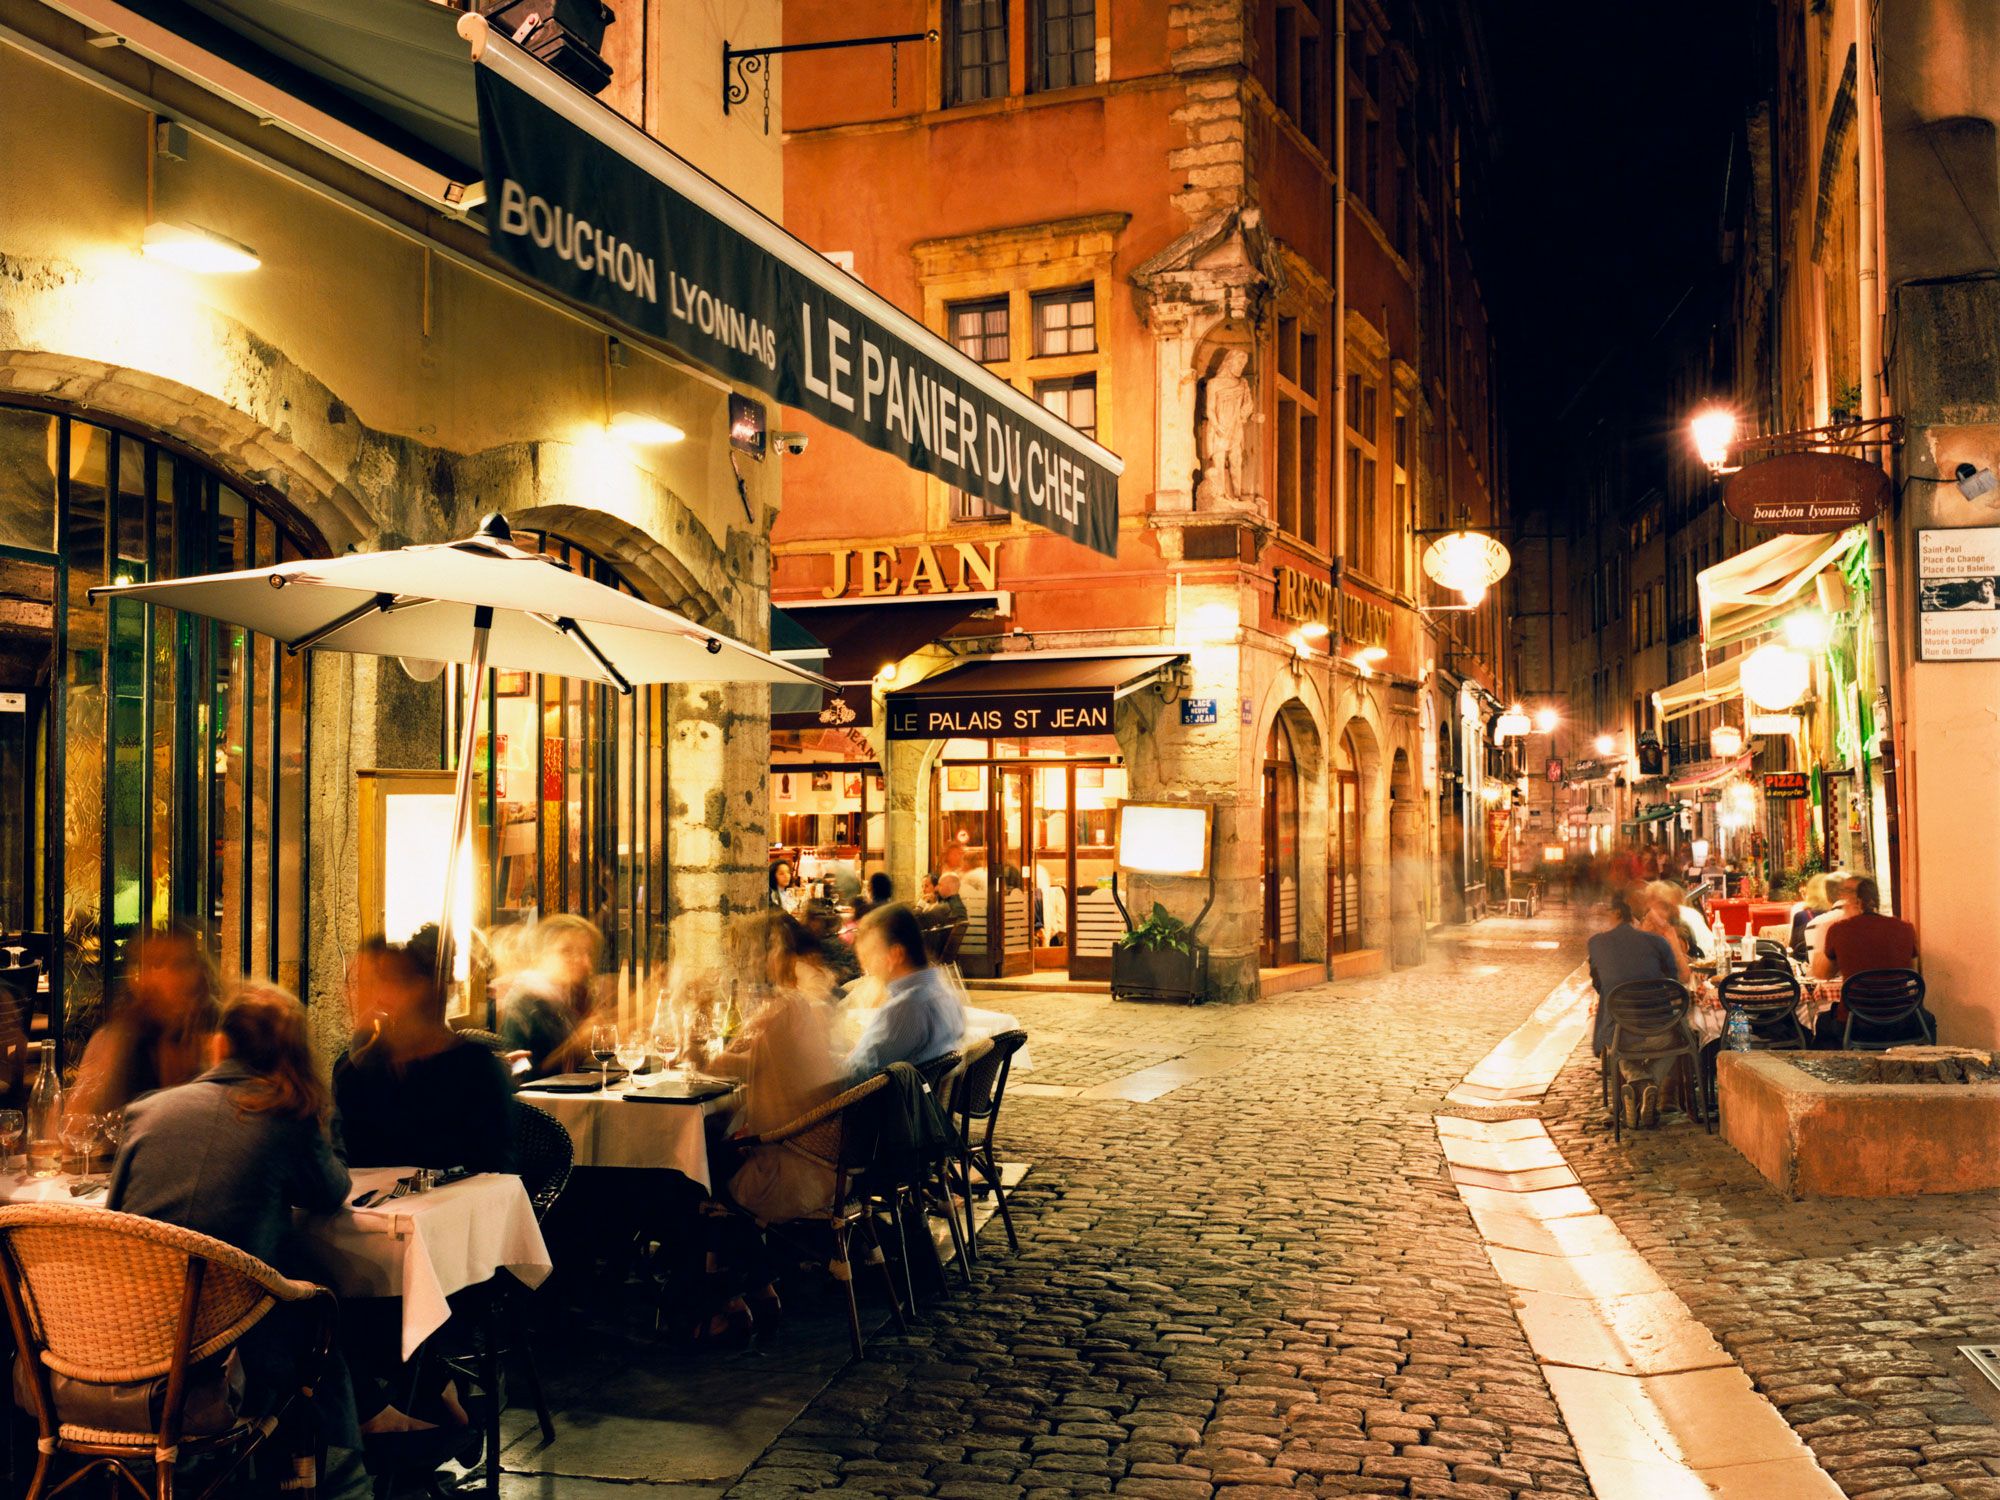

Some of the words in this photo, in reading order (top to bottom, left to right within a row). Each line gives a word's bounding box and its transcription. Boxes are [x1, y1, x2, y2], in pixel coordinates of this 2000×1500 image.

[500, 178, 657, 304] BOUCHON
[669, 270, 776, 371] LYONNAIS
[802, 303, 855, 413] LE
[862, 339, 982, 477] PANIER
[986, 412, 1022, 495] DU
[1026, 440, 1086, 525] CHEF
[1753, 505, 1804, 519] bouchon
[1808, 503, 1861, 519] lyonnais
[1922, 545, 1962, 554] Saint-Paul
[1956, 555, 1985, 564] Change
[821, 541, 1001, 599] JEAN
[1923, 566, 1944, 574] Place
[1957, 565, 1965, 573] la
[1966, 564, 1995, 573] Baleine
[1282, 565, 1392, 645] RESTAURANT
[1924, 627, 1949, 636] Mairie
[1951, 627, 1978, 635] annexe
[1924, 648, 1940, 656] Rue
[1941, 648, 1952, 656] du
[893, 713, 918, 732] LE
[928, 710, 1002, 731] PALAIS
[1013, 709, 1042, 729] ST
[1050, 707, 1108, 728] JEAN
[1194, 714, 1216, 723] JEAN
[846, 727, 877, 761] JEAN
[1765, 774, 1804, 787] PIZZA
